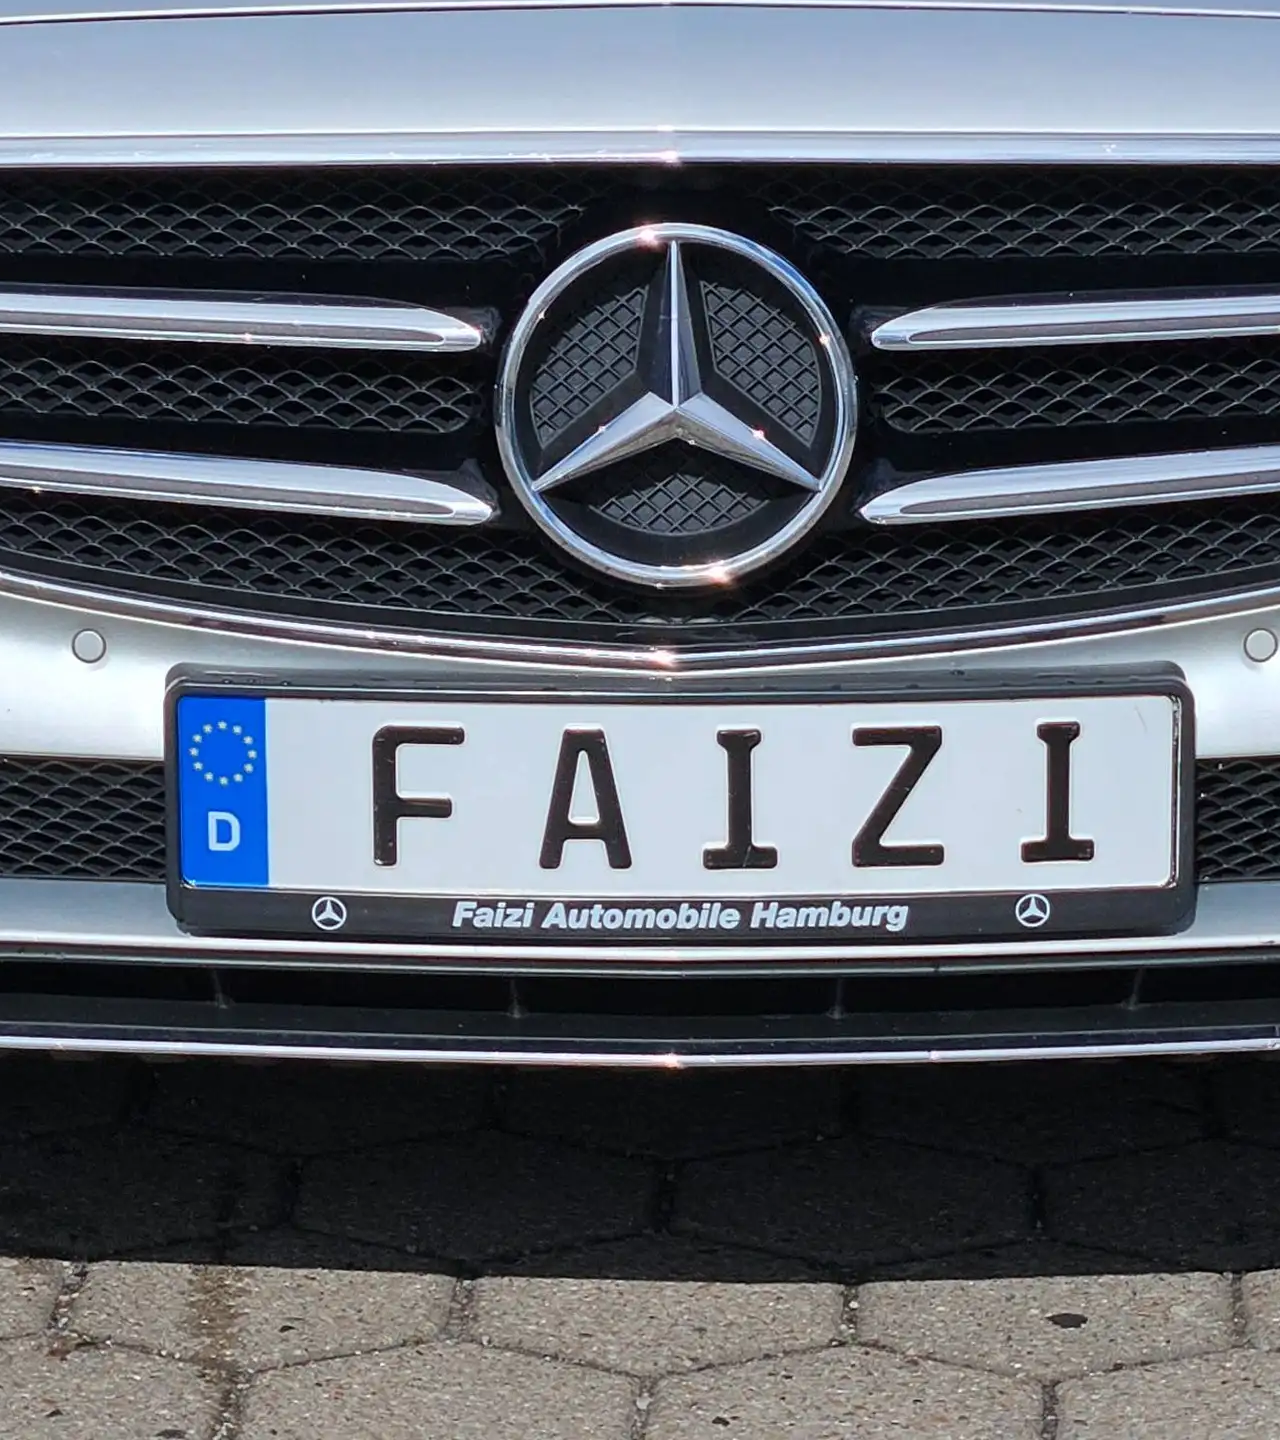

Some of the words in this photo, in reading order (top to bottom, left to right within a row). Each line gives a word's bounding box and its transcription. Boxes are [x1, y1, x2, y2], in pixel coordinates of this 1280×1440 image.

[207, 811, 241, 852] D
[371, 722, 1095, 869] FAIZI
[451, 901, 534, 928] Faizi
[541, 901, 741, 930] Automobile
[750, 901, 909, 932] Hamburg
